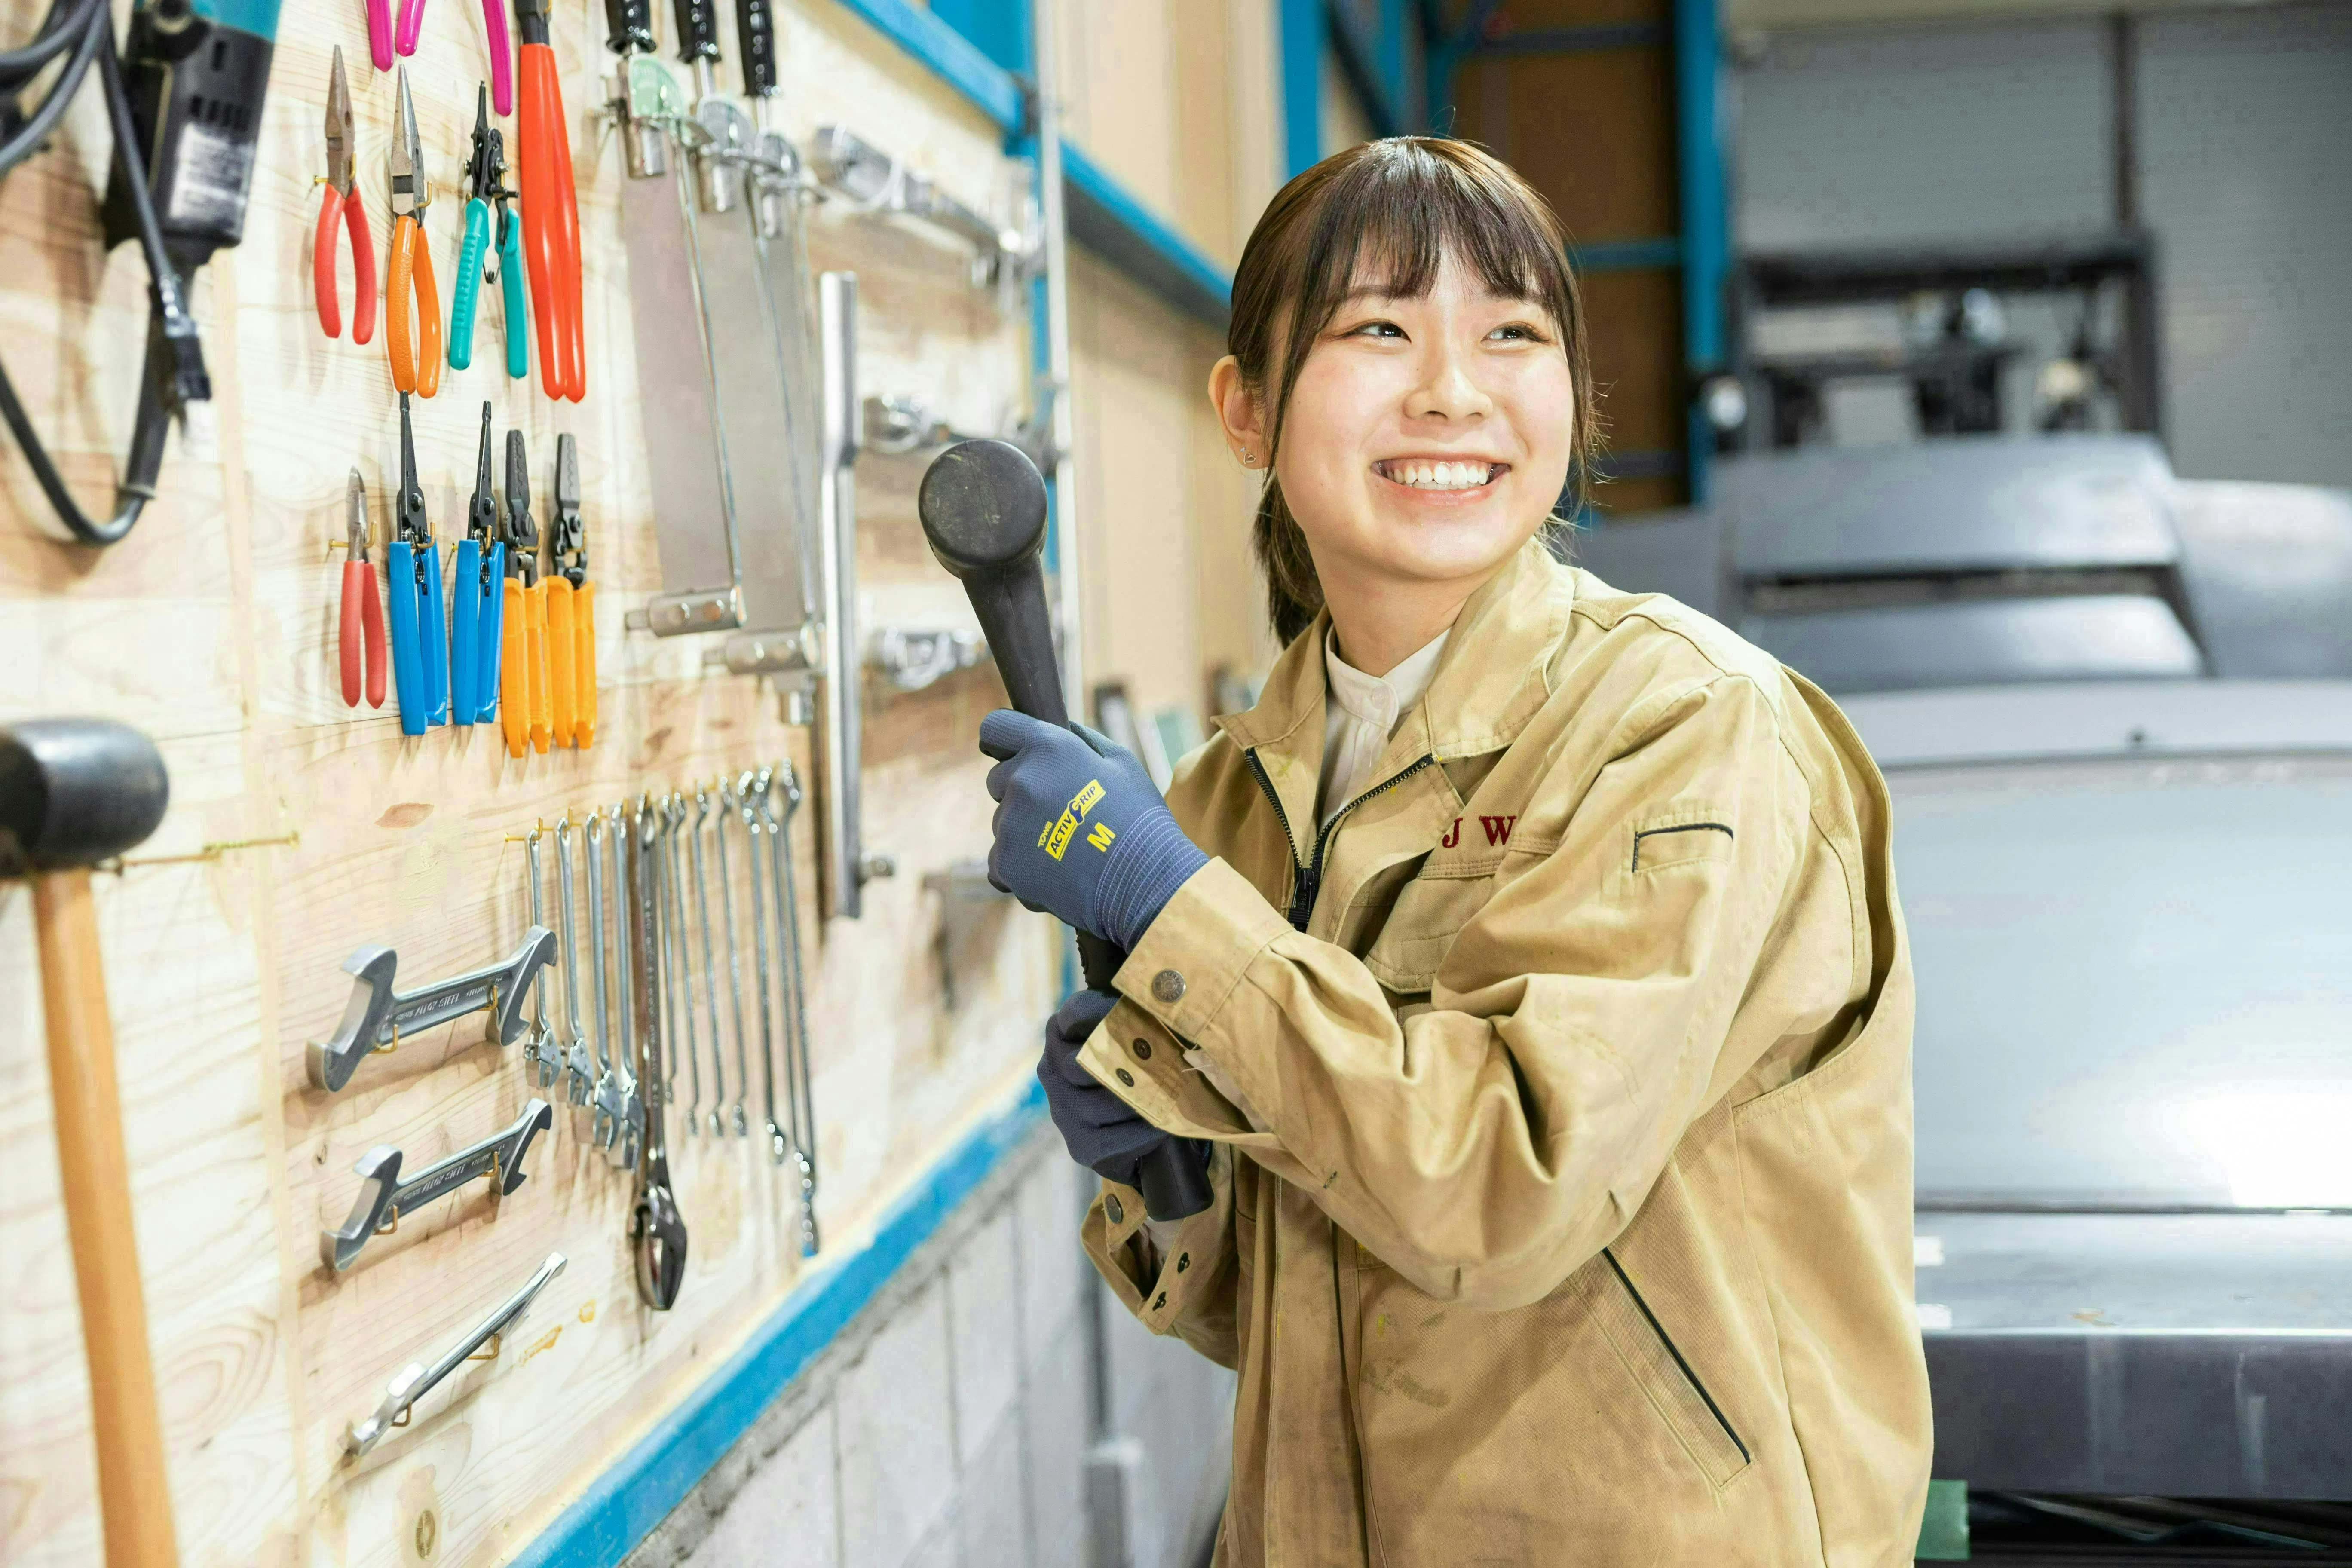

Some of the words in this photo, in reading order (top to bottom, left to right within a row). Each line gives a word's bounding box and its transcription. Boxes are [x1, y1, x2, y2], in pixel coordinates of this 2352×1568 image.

[1087, 822, 1116, 852] M
[1442, 818, 1463, 848] J
[1478, 816, 1517, 847] W
